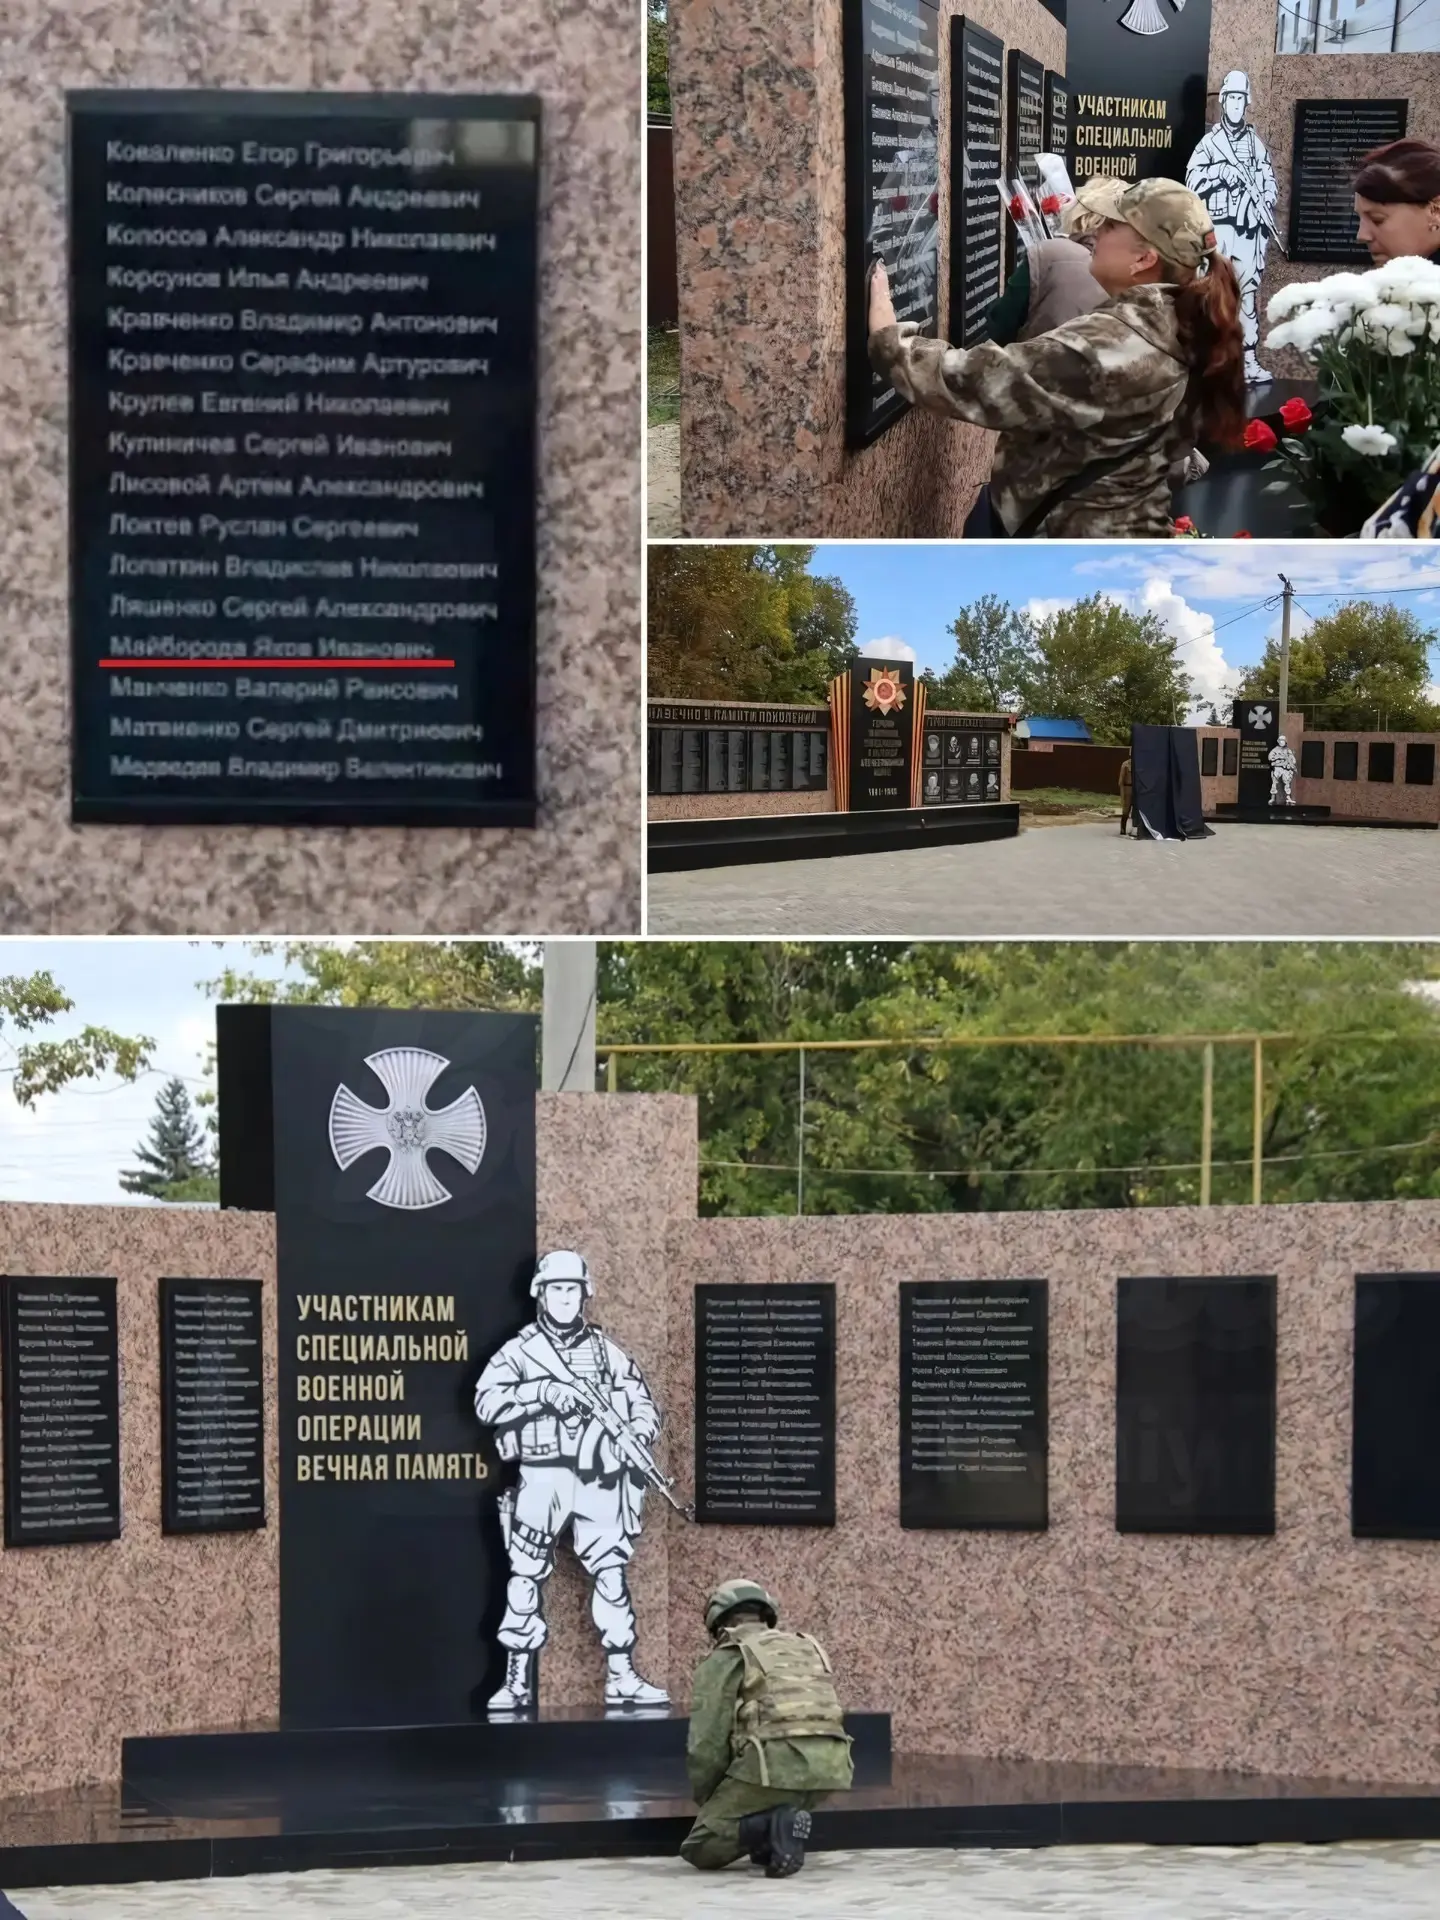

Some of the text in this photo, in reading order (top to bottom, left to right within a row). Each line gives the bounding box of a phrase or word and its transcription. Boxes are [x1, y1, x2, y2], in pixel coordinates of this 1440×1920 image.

[1077, 94, 1167, 120] УЧАСТНИКАМ
[1075, 123, 1173, 150] СПЕЦИАЛЬНОЙ
[107, 141, 234, 163] Коваленко
[242, 141, 298, 167] Егор
[1075, 152, 1137, 177] ВОЕННОЙ
[256, 184, 340, 210] Сергей
[348, 185, 479, 210] Андреевич
[215, 226, 344, 252] Александр
[352, 228, 496, 250] Николаевич
[229, 268, 289, 287] Илья
[297, 269, 428, 293] Андреевич
[108, 307, 497, 334] Кравченко Владимир Антонович
[109, 349, 488, 379] Кравченко Серафим Артурович
[202, 392, 298, 412] Евгений
[306, 393, 449, 415] Николаевич
[245, 432, 329, 458] Сергей
[337, 435, 451, 456] Иванович
[110, 472, 210, 495] Лисовой
[299, 476, 483, 501] Александрович
[110, 513, 419, 541] Локтев Руслан Сергеевич
[226, 556, 353, 579] Владислав
[361, 557, 497, 578] Николаевич
[223, 596, 309, 620] Сергей
[315, 598, 497, 623] Александрович
[110, 635, 434, 658] Майборода Яков Иванович
[236, 678, 339, 701] Валерий
[247, 717, 332, 742] Сергей
[336, 718, 481, 742] Дмитриевич
[228, 757, 340, 781] Владимир
[297, 1294, 456, 1323] УЧАСТНИКАМ
[297, 1330, 469, 1364] СПЕЦИАЛЬНОЙ
[297, 1370, 405, 1402] ВОЕННОЙ
[297, 1414, 422, 1444] ОПЕРАЦИИ
[297, 1452, 489, 1482] ВЕЧНАЯ ПАМЯТЬ
